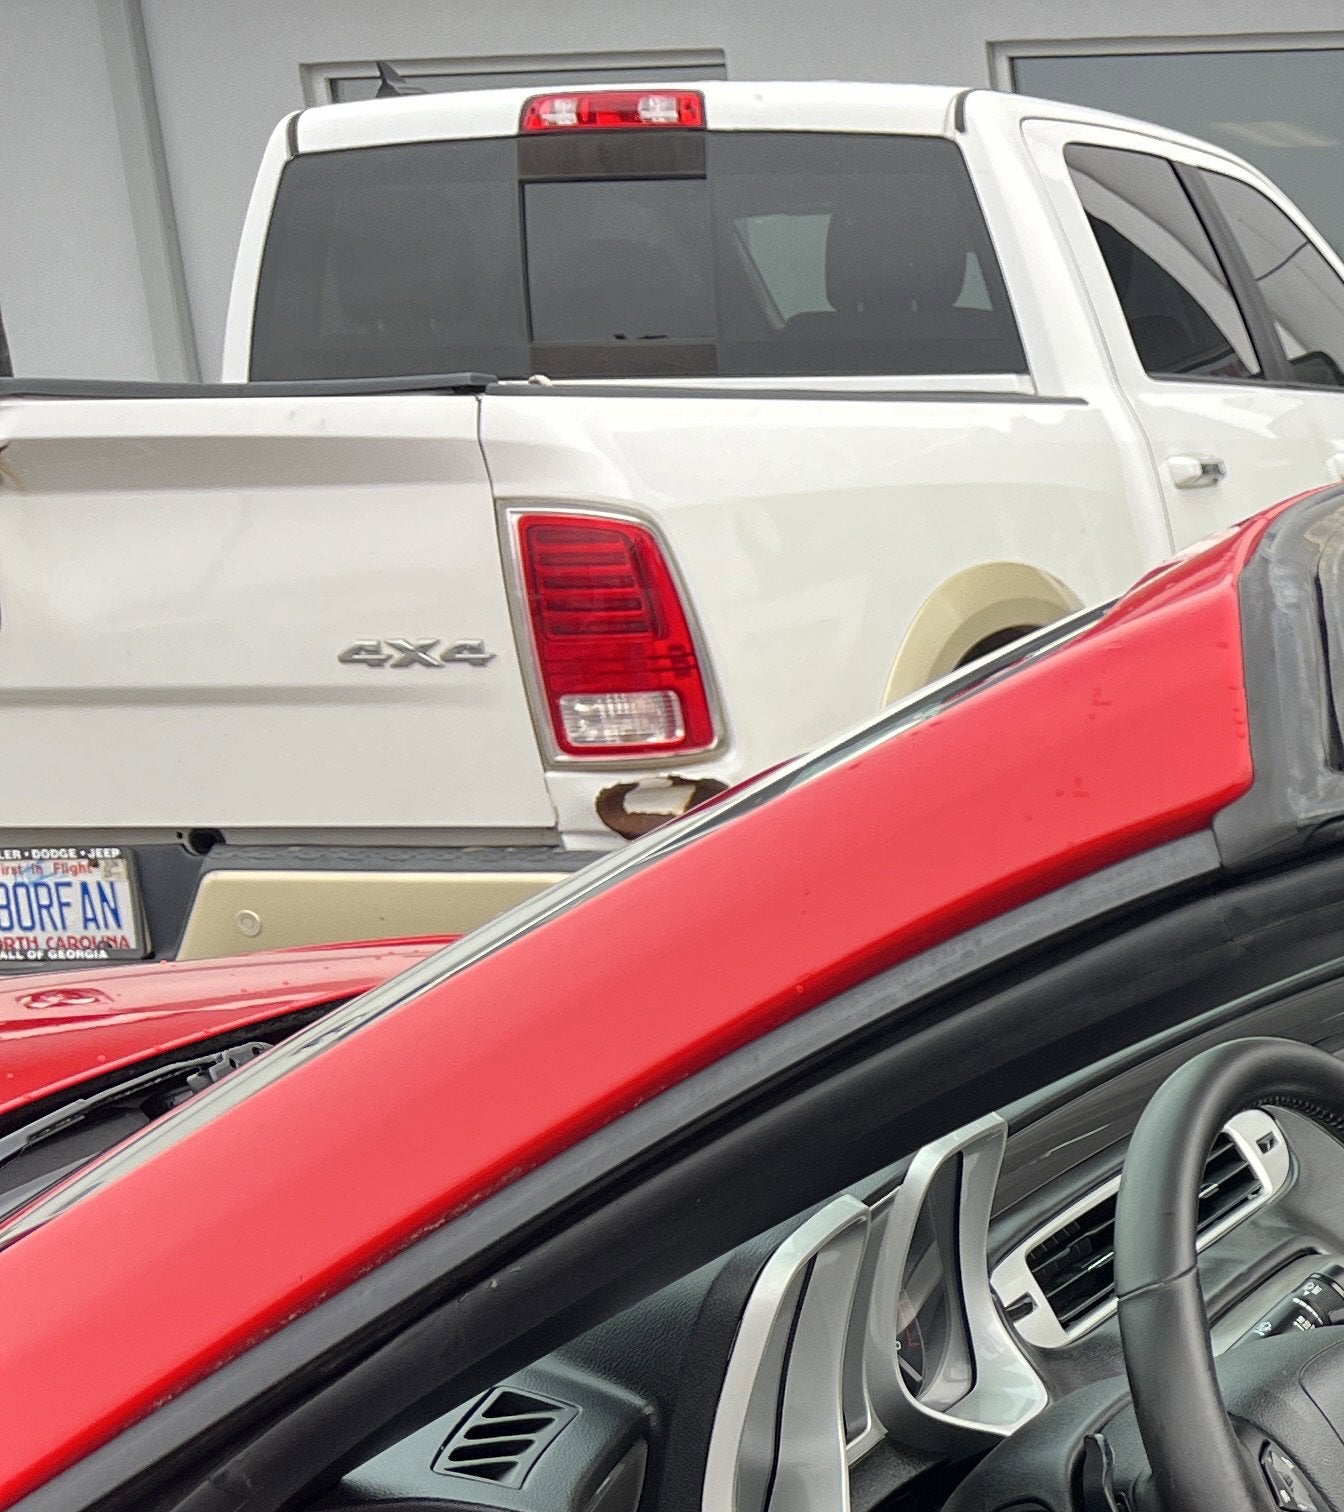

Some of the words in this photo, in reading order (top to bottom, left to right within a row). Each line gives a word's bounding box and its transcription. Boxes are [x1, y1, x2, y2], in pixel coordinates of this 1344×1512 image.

[31, 848, 77, 860] DODGE
[88, 847, 121, 859] JEEP
[1, 862, 22, 876] irst
[53, 862, 93, 877] Flight
[0, 935, 38, 950] RTH
[26, 949, 44, 961] OF
[47, 948, 109, 961] GEORGIA
